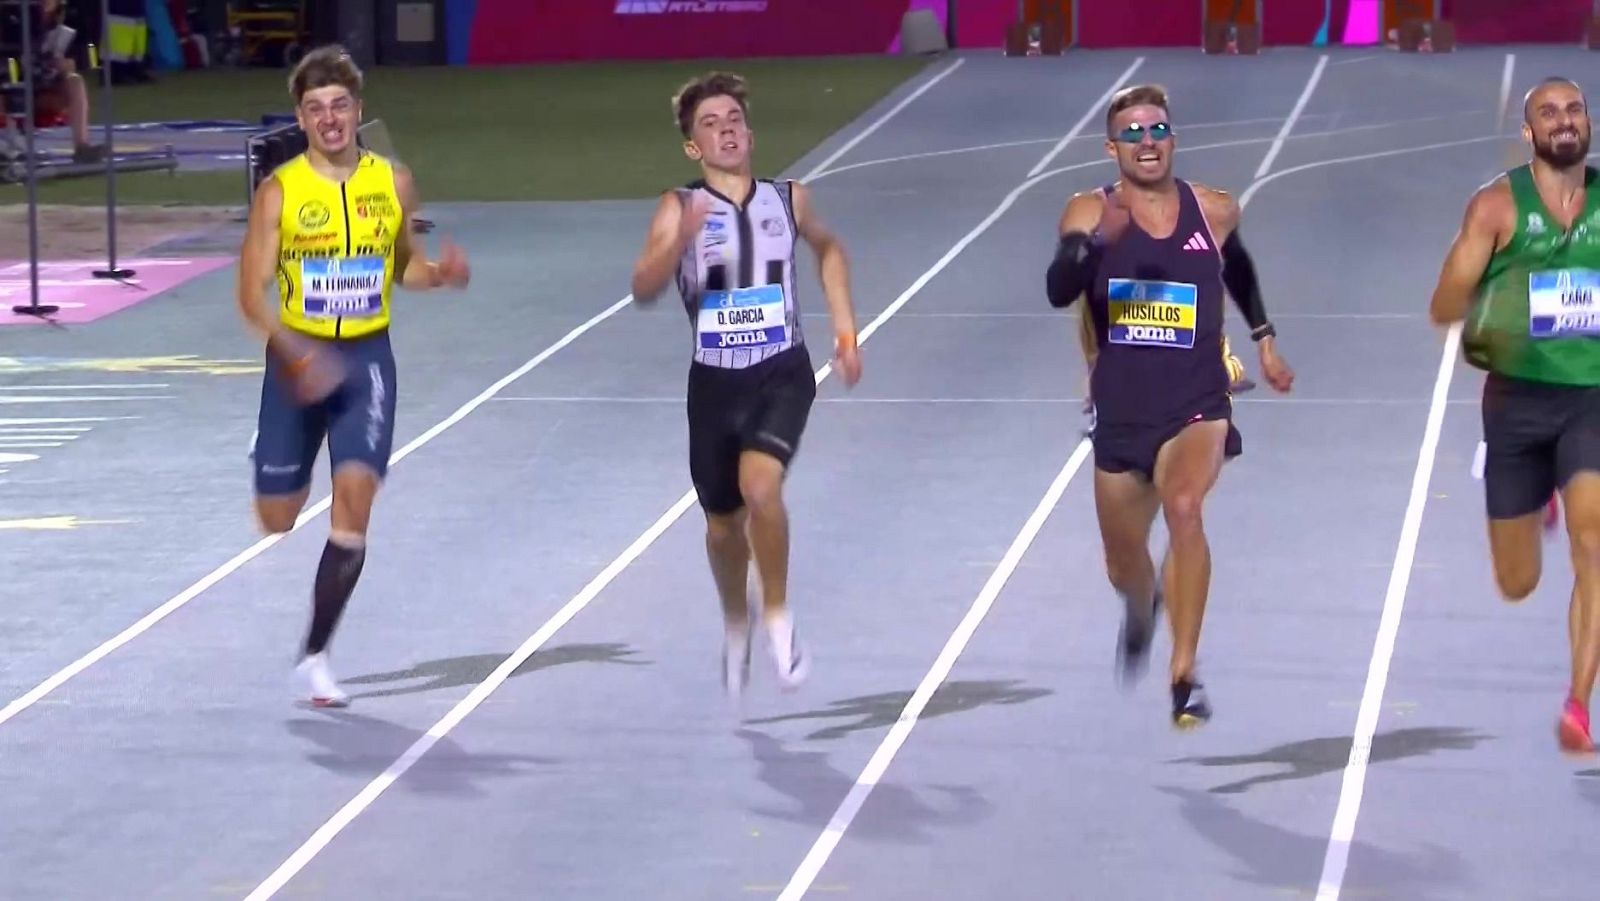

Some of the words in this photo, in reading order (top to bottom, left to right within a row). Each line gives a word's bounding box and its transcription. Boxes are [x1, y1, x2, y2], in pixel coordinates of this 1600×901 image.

[717, 310, 728, 325] D.
[728, 307, 765, 325] GARCIA
[1122, 303, 1181, 323] HUSILLOS
